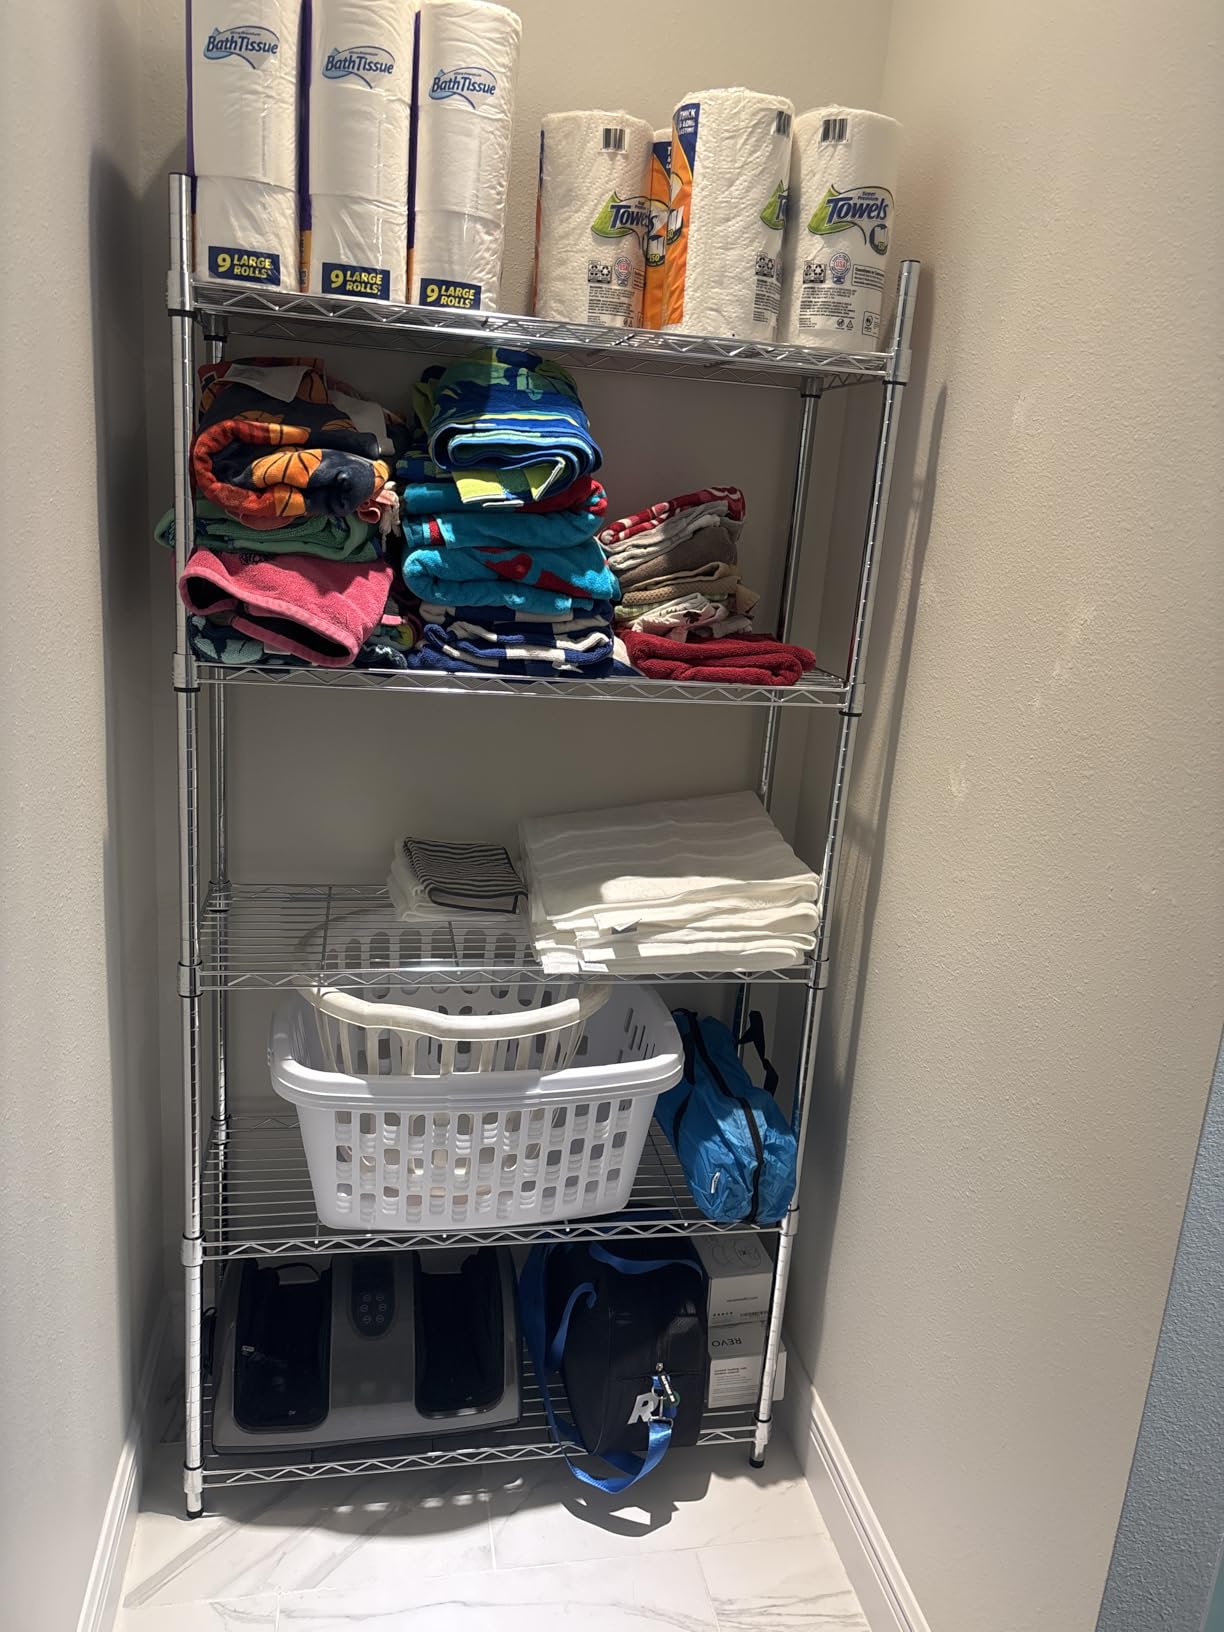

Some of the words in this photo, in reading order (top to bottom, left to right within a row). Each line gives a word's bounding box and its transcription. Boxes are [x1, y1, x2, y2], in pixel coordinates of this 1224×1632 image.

[825, 197, 889, 225] Towels
[217, 253, 231, 272] 9
[233, 254, 273, 269] LARGE
[330, 269, 344, 289] 9
[346, 270, 383, 285] LARGE
[426, 284, 439, 303] 9
[441, 285, 476, 300] LARGE
[711, 1337, 743, 1348] REVO
